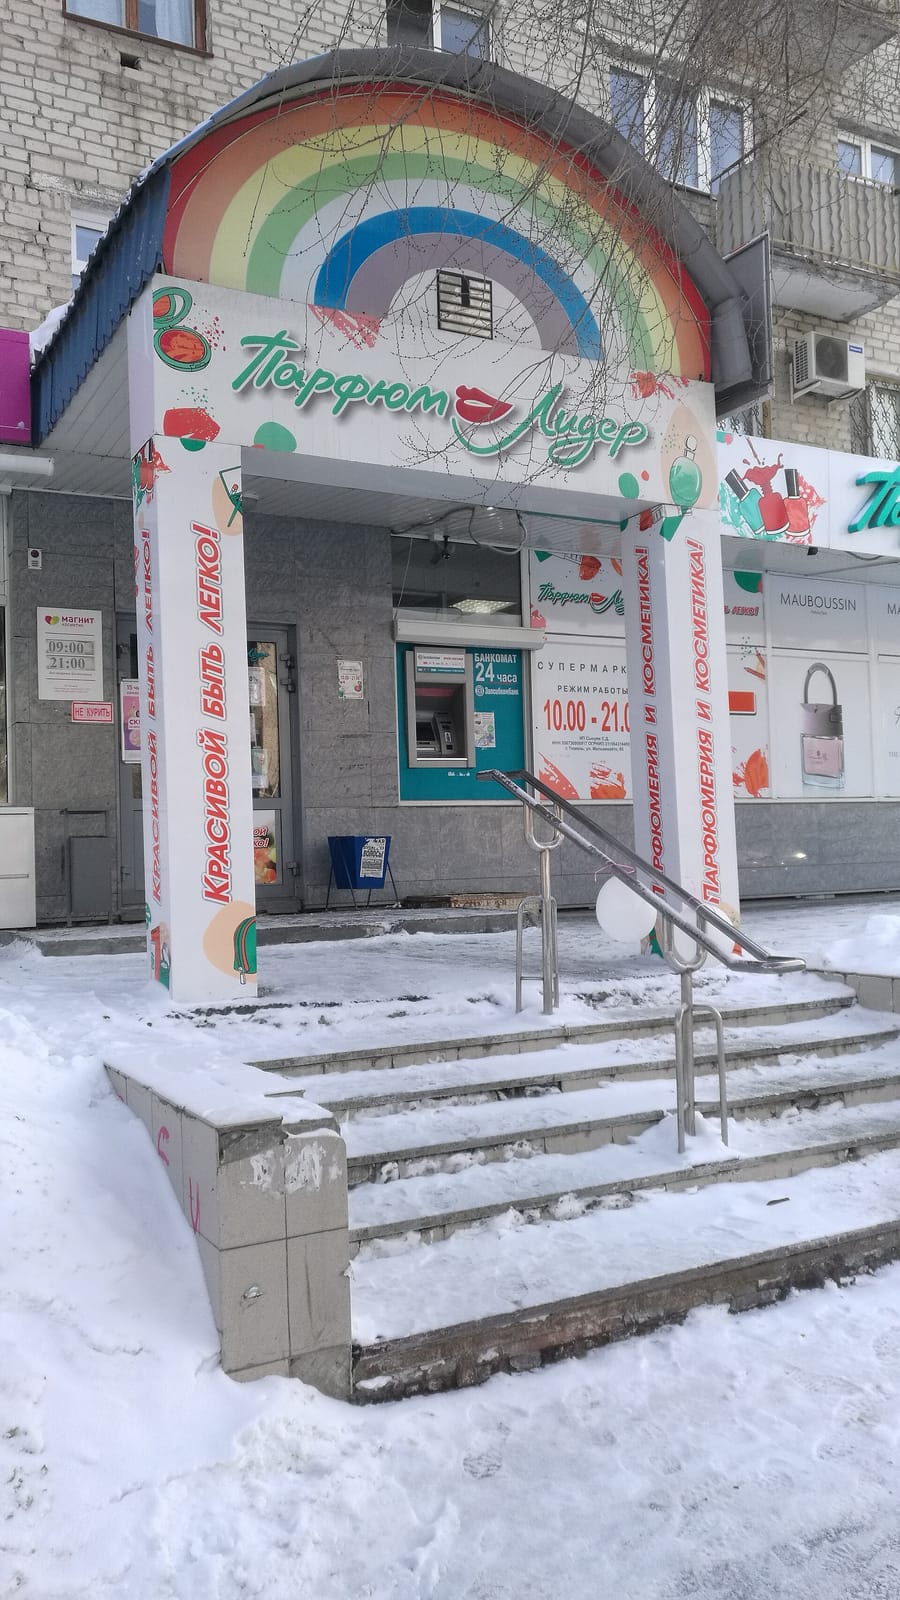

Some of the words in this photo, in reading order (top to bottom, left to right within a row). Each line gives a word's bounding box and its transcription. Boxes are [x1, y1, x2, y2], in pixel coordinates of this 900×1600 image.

[232, 331, 448, 415] Парфюм
[451, 383, 648, 466] Лидер
[142, 530, 154, 634] ЛЕГКО!
[192, 523, 223, 634] ЛЕГКО!
[538, 582, 590, 606] Парфюм
[780, 593, 857, 611] MAUBOUSSIN
[635, 547, 656, 695] КОСМЕТИКА!
[687, 537, 711, 693] КОСМЕТИКА!
[48, 641, 84, 653] 09:00
[474, 653, 517, 664] БАНКОМАТ
[49, 657, 85, 669] 21:00
[475, 662, 495, 682] 24
[496, 674, 518, 683] часа
[146, 643, 156, 718] БЫТЬ
[200, 643, 226, 718] БЫТЬ
[557, 684, 590, 693] РЕЖИМ
[592, 686, 630, 695] РАБОТЫ
[75, 707, 84, 717] НЕ
[86, 707, 111, 718] КУРИТЬ
[543, 699, 586, 732] 10.00
[644, 706, 657, 724] И
[696, 699, 713, 724] И
[697, 729, 720, 904] ПАРФЮМЕРИЯ
